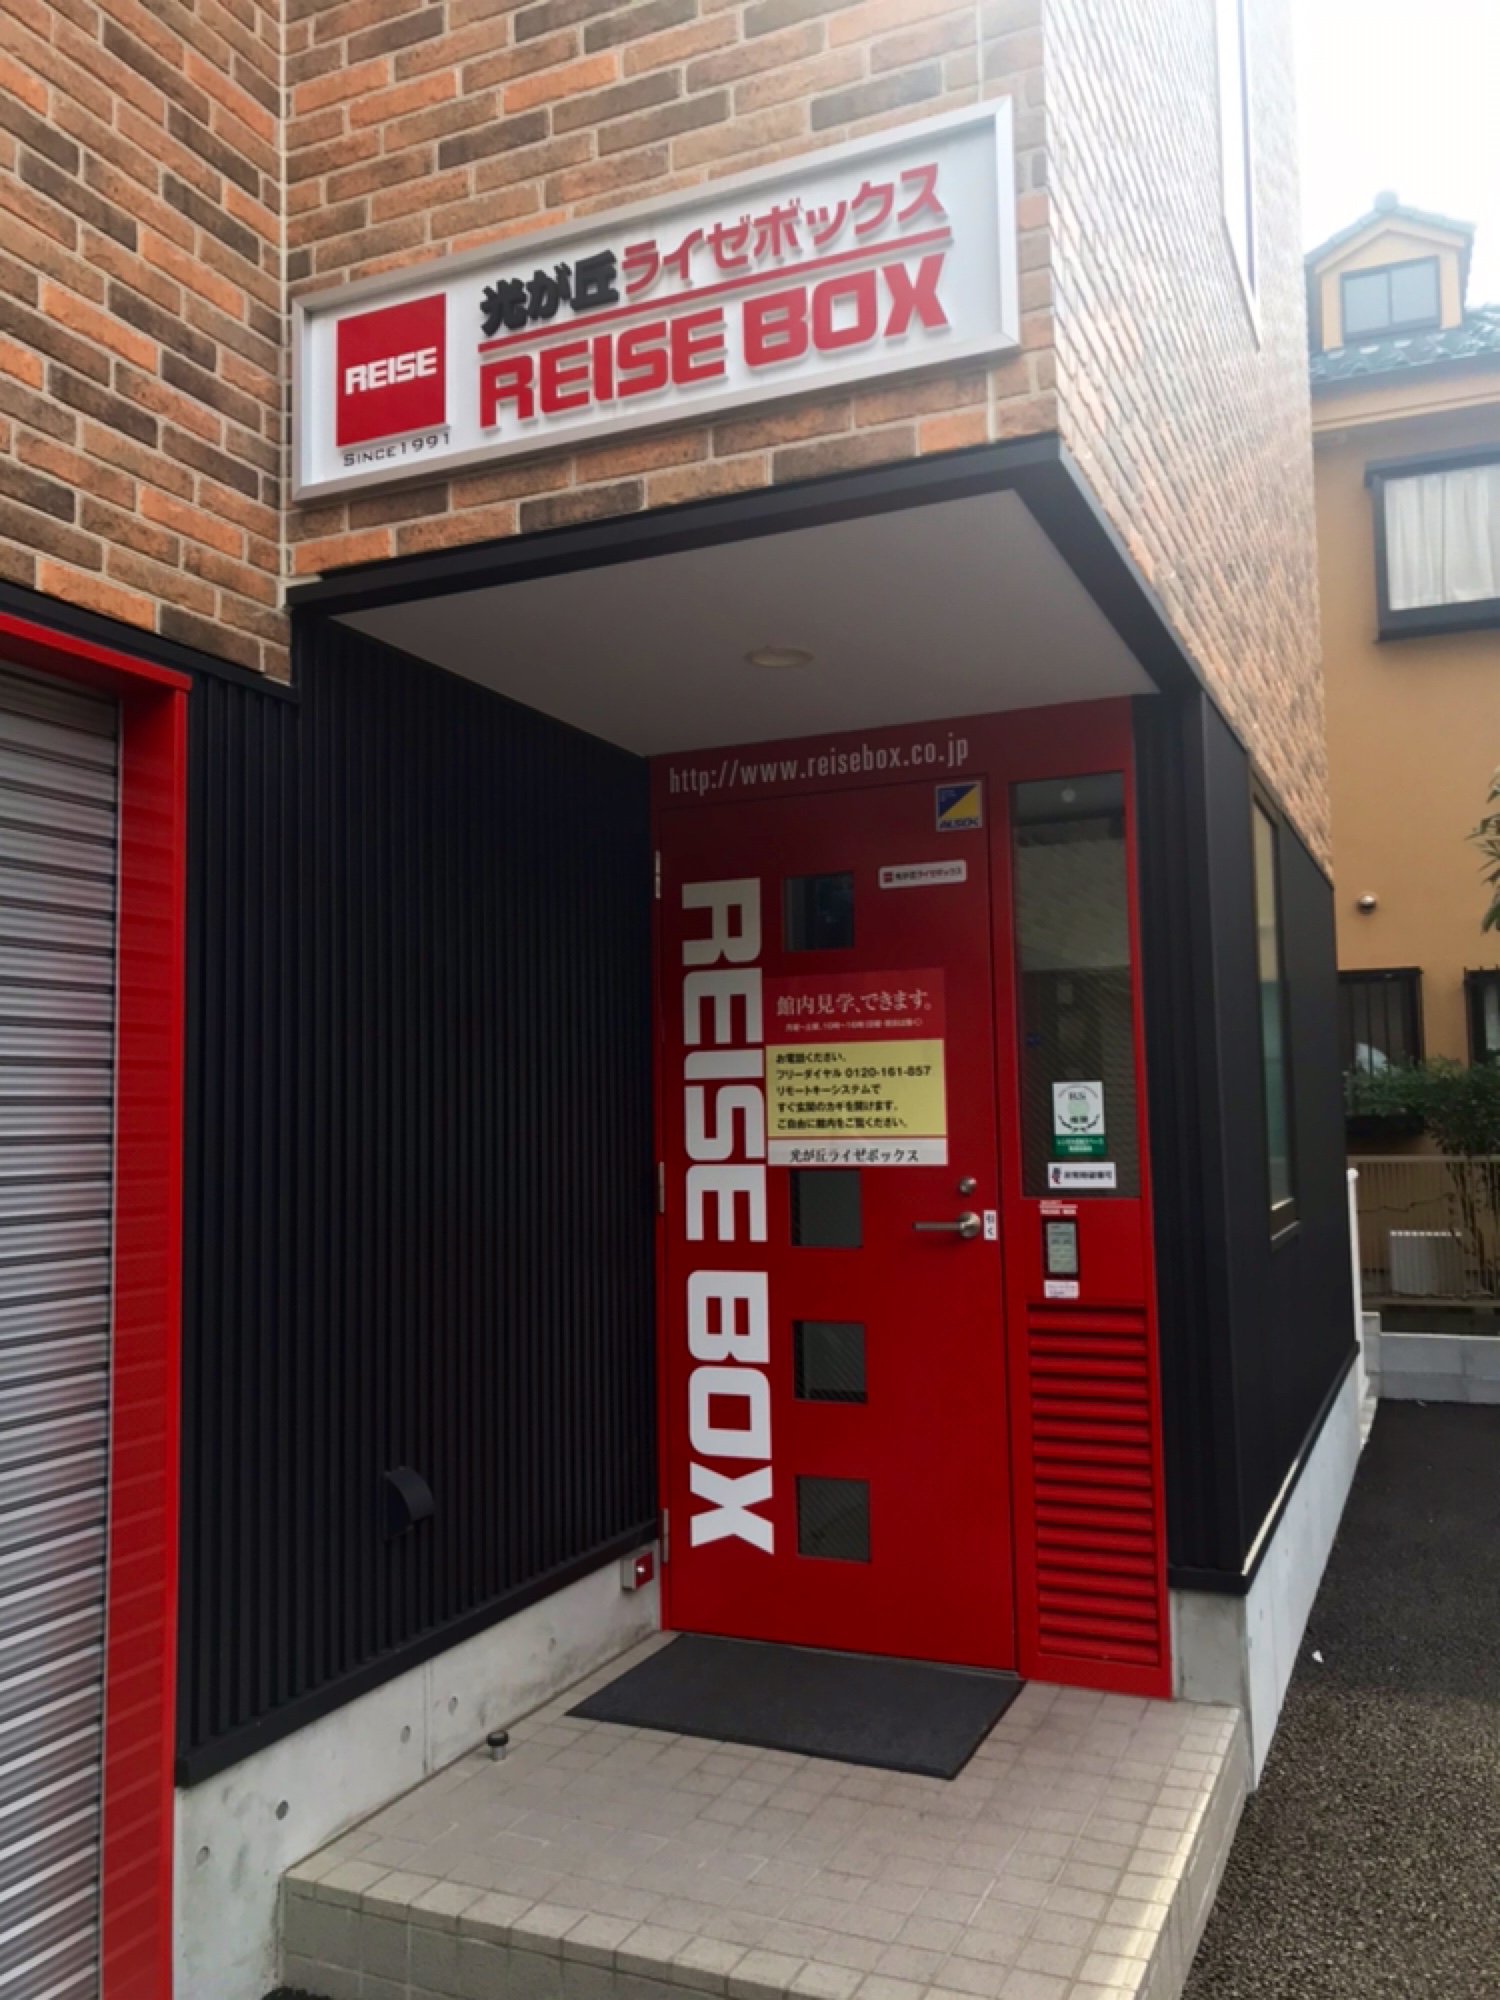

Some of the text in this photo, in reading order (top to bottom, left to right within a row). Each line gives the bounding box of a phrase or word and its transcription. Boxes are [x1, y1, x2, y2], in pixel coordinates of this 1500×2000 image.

[480, 162, 945, 336] 光が丘ライゼボックス
[344, 345, 438, 395] REISE
[479, 253, 950, 430] REISE BOX
[669, 732, 969, 797] http://www.reisebox.co.jp
[776, 987, 932, 1017] 館内見学、できます。
[776, 1083, 881, 1096] リモートキーシステムで
[789, 1147, 919, 1163] 光が丘ライゼボックス
[681, 877, 774, 1555] REISE BOX
